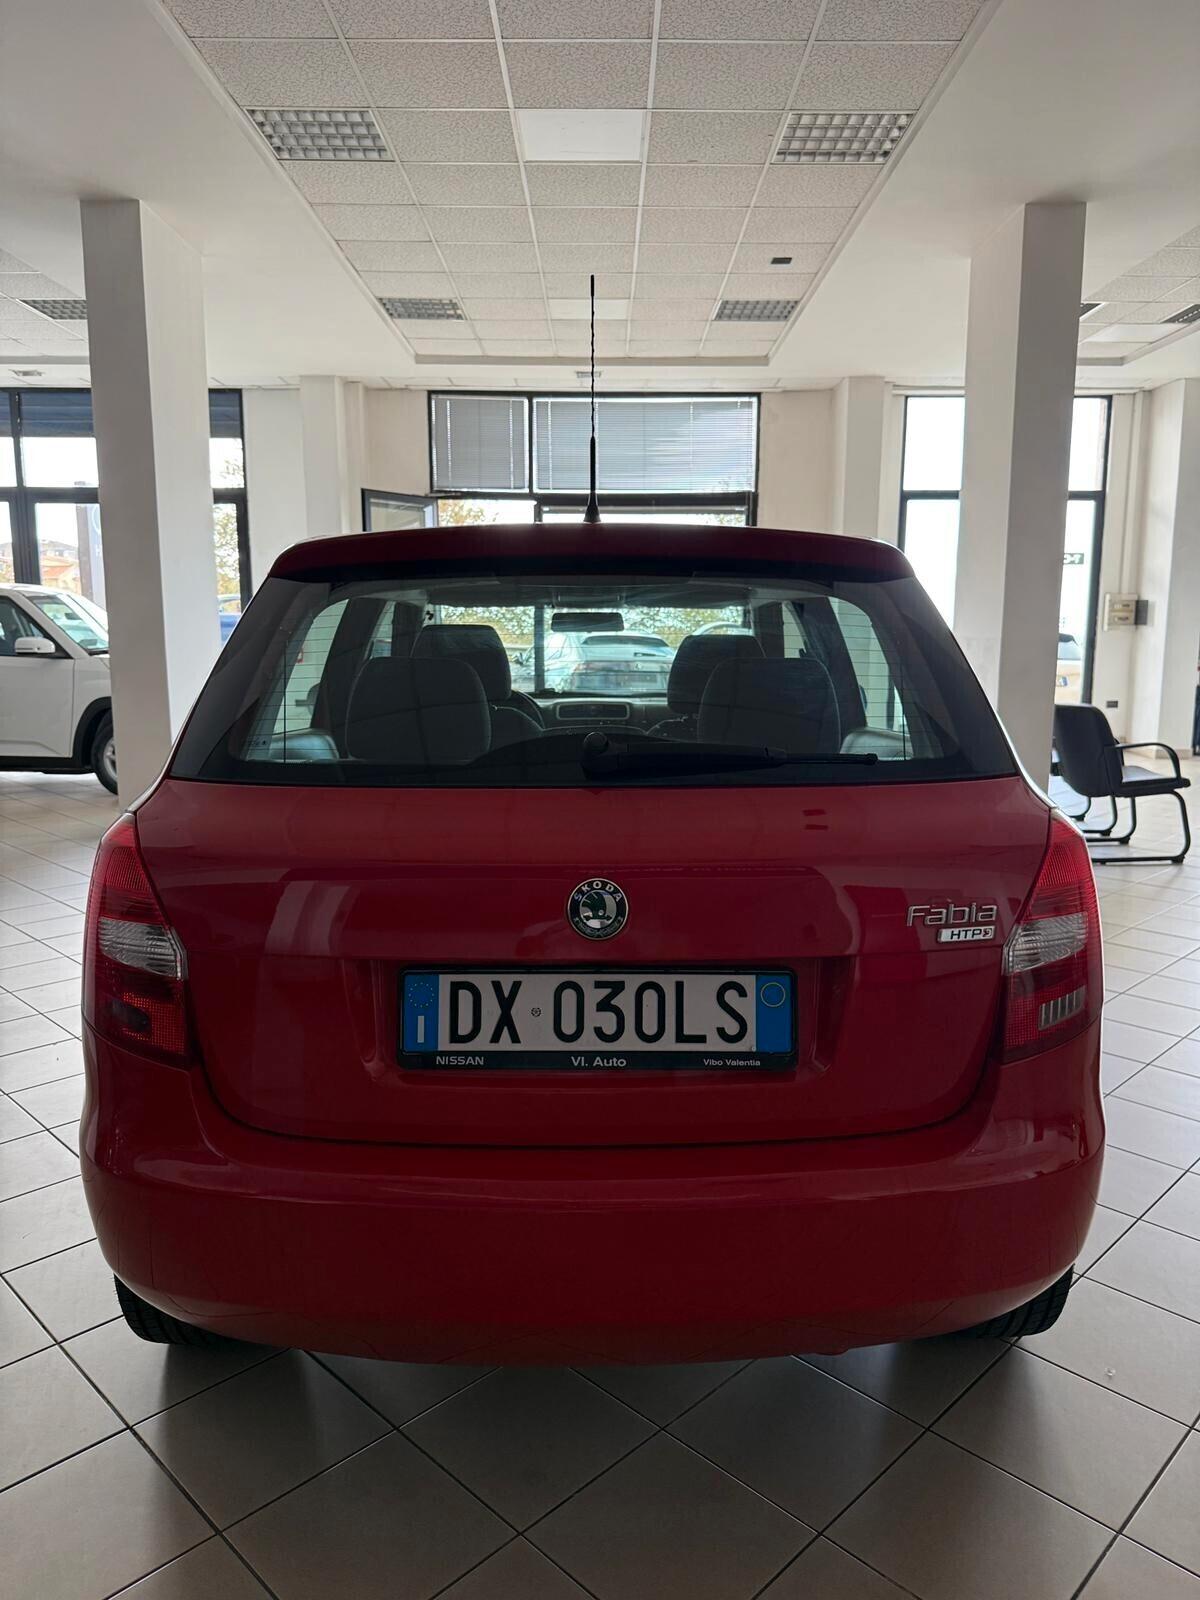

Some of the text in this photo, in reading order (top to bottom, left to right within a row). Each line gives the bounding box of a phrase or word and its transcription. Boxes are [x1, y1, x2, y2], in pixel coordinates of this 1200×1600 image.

[906, 902, 998, 927] Fabia
[950, 928, 983, 940] HTP
[448, 980, 749, 1044] DX 030LS
[417, 1015, 425, 1043] I
[435, 1055, 485, 1066] NISSAN
[570, 1056, 627, 1067] VI. Auto
[703, 1058, 761, 1067] Vibo Valentia
